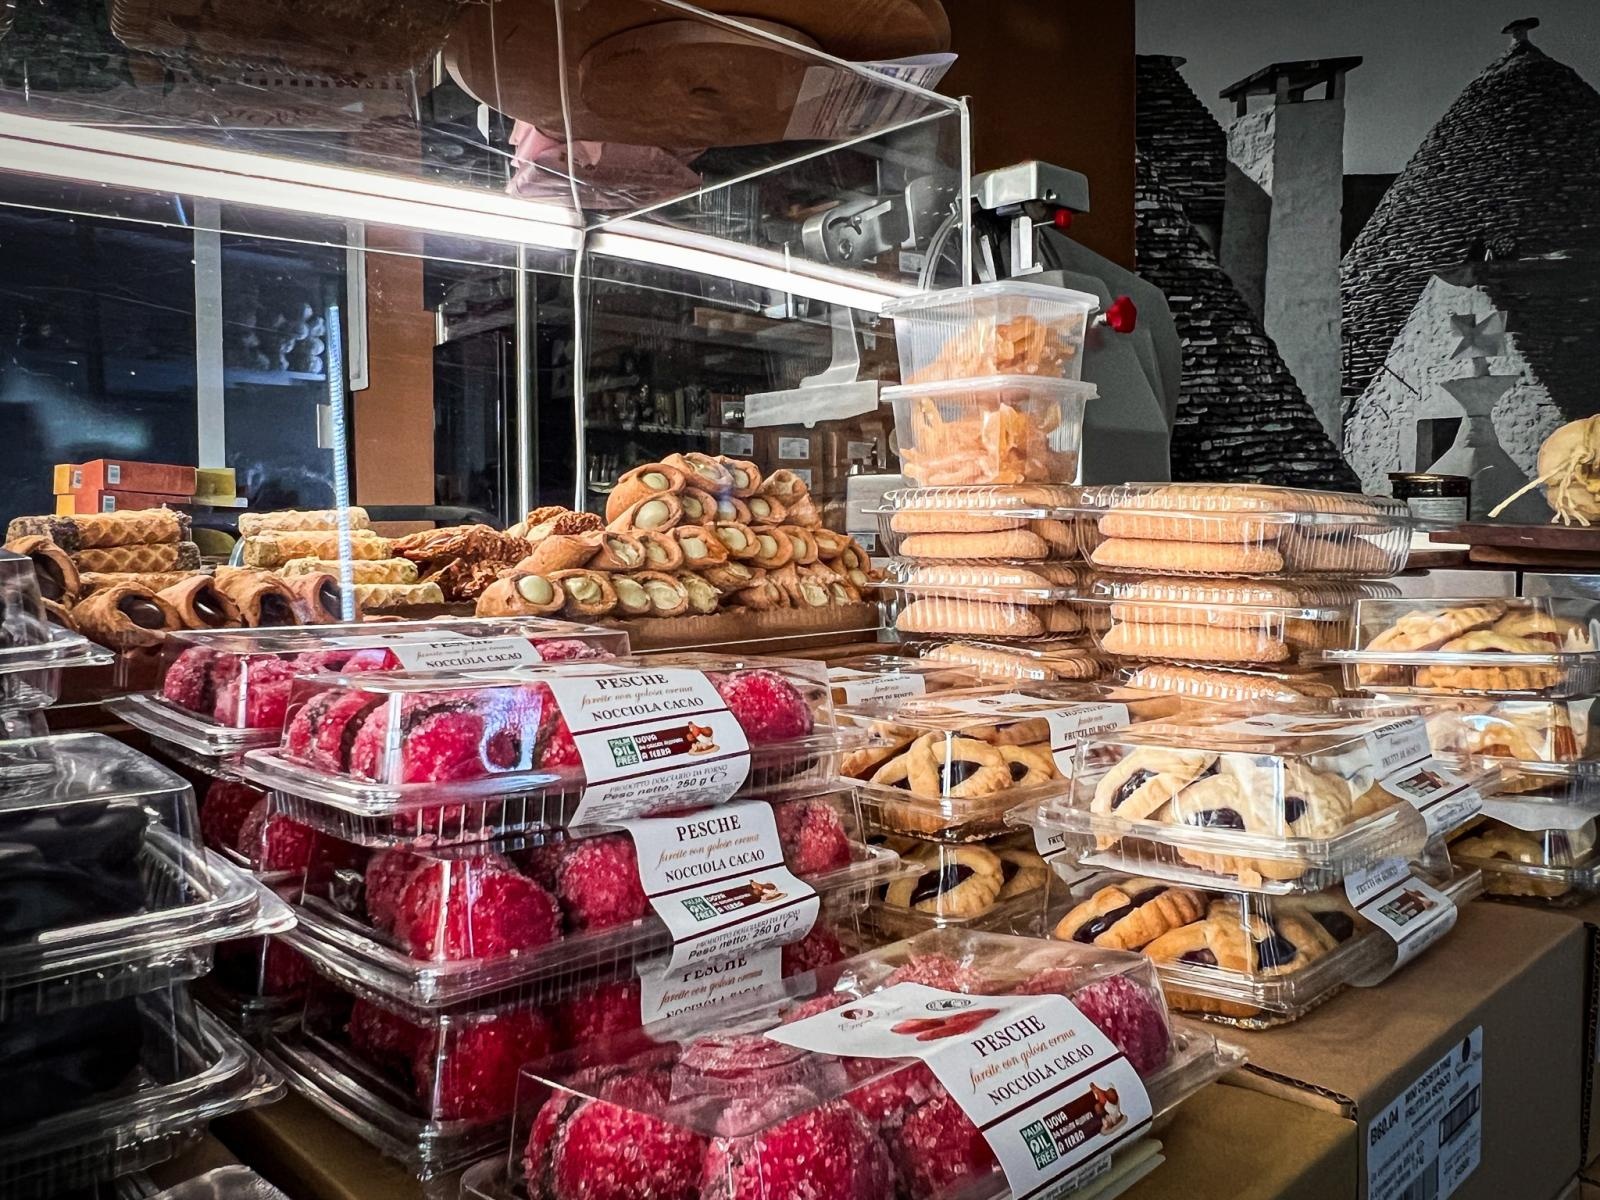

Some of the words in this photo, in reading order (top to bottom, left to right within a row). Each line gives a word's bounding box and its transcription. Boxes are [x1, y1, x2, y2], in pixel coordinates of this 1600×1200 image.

[425, 657, 485, 668] NOCCIOLA
[486, 652, 522, 663] CACAO
[595, 674, 669, 690] PESCHE
[592, 703, 662, 722] NOCCIOLA
[663, 697, 704, 711] CACAO
[635, 733, 658, 744] UOVA
[613, 743, 636, 757] OIL
[615, 755, 640, 767] FREE
[602, 788, 634, 801] Peso
[698, 777, 708, 787] g
[676, 814, 742, 842] PESCHE
[665, 860, 727, 883] NOCCIOLA
[728, 849, 765, 867] CACAO
[688, 944, 717, 960] Peso
[773, 922, 781, 934] g
[970, 1015, 1045, 1057] PESCHE
[1001, 1056, 1020, 1071] con
[1019, 1043, 1050, 1069] golosa
[987, 1065, 1056, 1105] NOCCIOLA
[1053, 1043, 1094, 1071] CACAO
[1022, 1122, 1043, 1139] PALM
[1046, 1111, 1068, 1129] UOVA
[1029, 1135, 1051, 1154] OIL
[1058, 1141, 1065, 1153] A
[1064, 1130, 1085, 1149] TERRA
[1036, 1149, 1057, 1169] FREE
